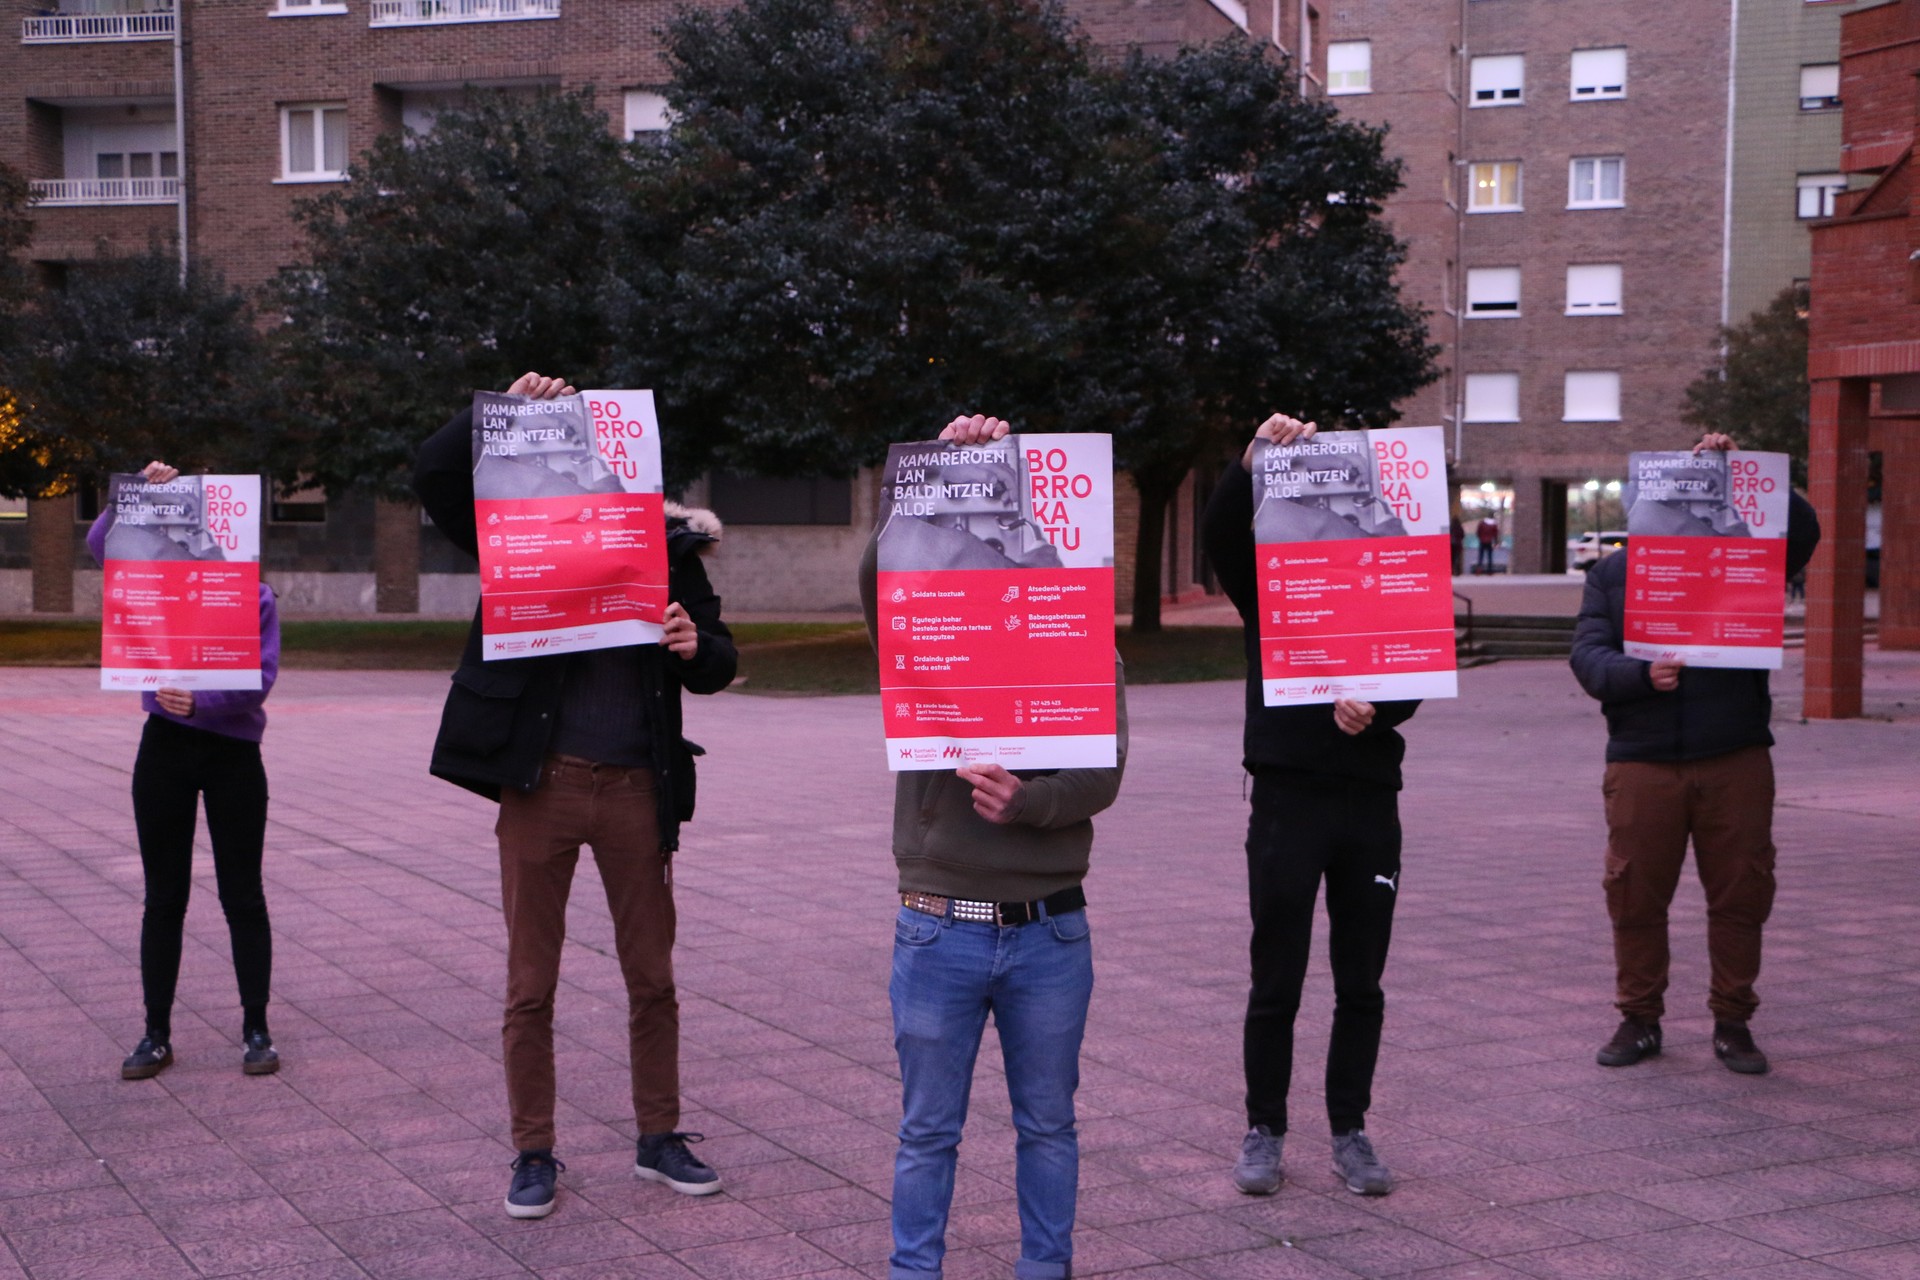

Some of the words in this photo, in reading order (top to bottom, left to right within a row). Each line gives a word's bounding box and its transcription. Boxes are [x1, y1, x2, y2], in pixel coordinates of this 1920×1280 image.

[483, 402, 572, 417] KAMAREROEN
[589, 401, 621, 419] BO
[483, 418, 506, 429] LAN
[595, 421, 642, 439] RRO
[483, 429, 565, 442] BALDINTZEN
[482, 444, 517, 456] ALDE
[598, 441, 627, 459] KA
[1265, 443, 1357, 459] KAMAREROEN
[1375, 441, 1407, 460] BO
[898, 450, 1004, 468] KAMAREROEN
[1027, 449, 1067, 473] BO
[1265, 460, 1291, 472] LAN
[1639, 459, 1717, 469] KAMAREROEN
[609, 461, 637, 479] TU
[1380, 461, 1429, 480] RRO
[1639, 470, 1661, 480] LAN
[1731, 461, 1759, 475] BO
[896, 470, 924, 484] LAN
[1265, 470, 1349, 486] BALDINTZEN
[119, 483, 193, 494] KAMAREROEN
[207, 485, 232, 500] BO
[894, 483, 993, 500] BALDINTZEN
[1032, 474, 1092, 499] RRO
[1381, 482, 1412, 501] KA
[1638, 480, 1708, 490] BALDINTZEN
[1733, 478, 1775, 493] RRO
[117, 493, 140, 503] LAN
[1265, 487, 1301, 499] ALDE
[1638, 491, 1668, 500] ALDE
[1732, 494, 1758, 509] KA
[117, 505, 184, 515] BALDINTZEN
[208, 502, 247, 517] RRO
[893, 503, 935, 516] ALDE
[1032, 502, 1070, 525] KA
[1392, 503, 1421, 522] TU
[116, 515, 146, 525] ALDE
[208, 519, 231, 533] KA
[1740, 512, 1765, 527] TU
[215, 535, 237, 550] TU
[1044, 527, 1080, 551] TU
[1062, 585, 1086, 593] gabeko
[1028, 594, 1060, 602] egutegiak
[945, 655, 969, 663] gabeko
